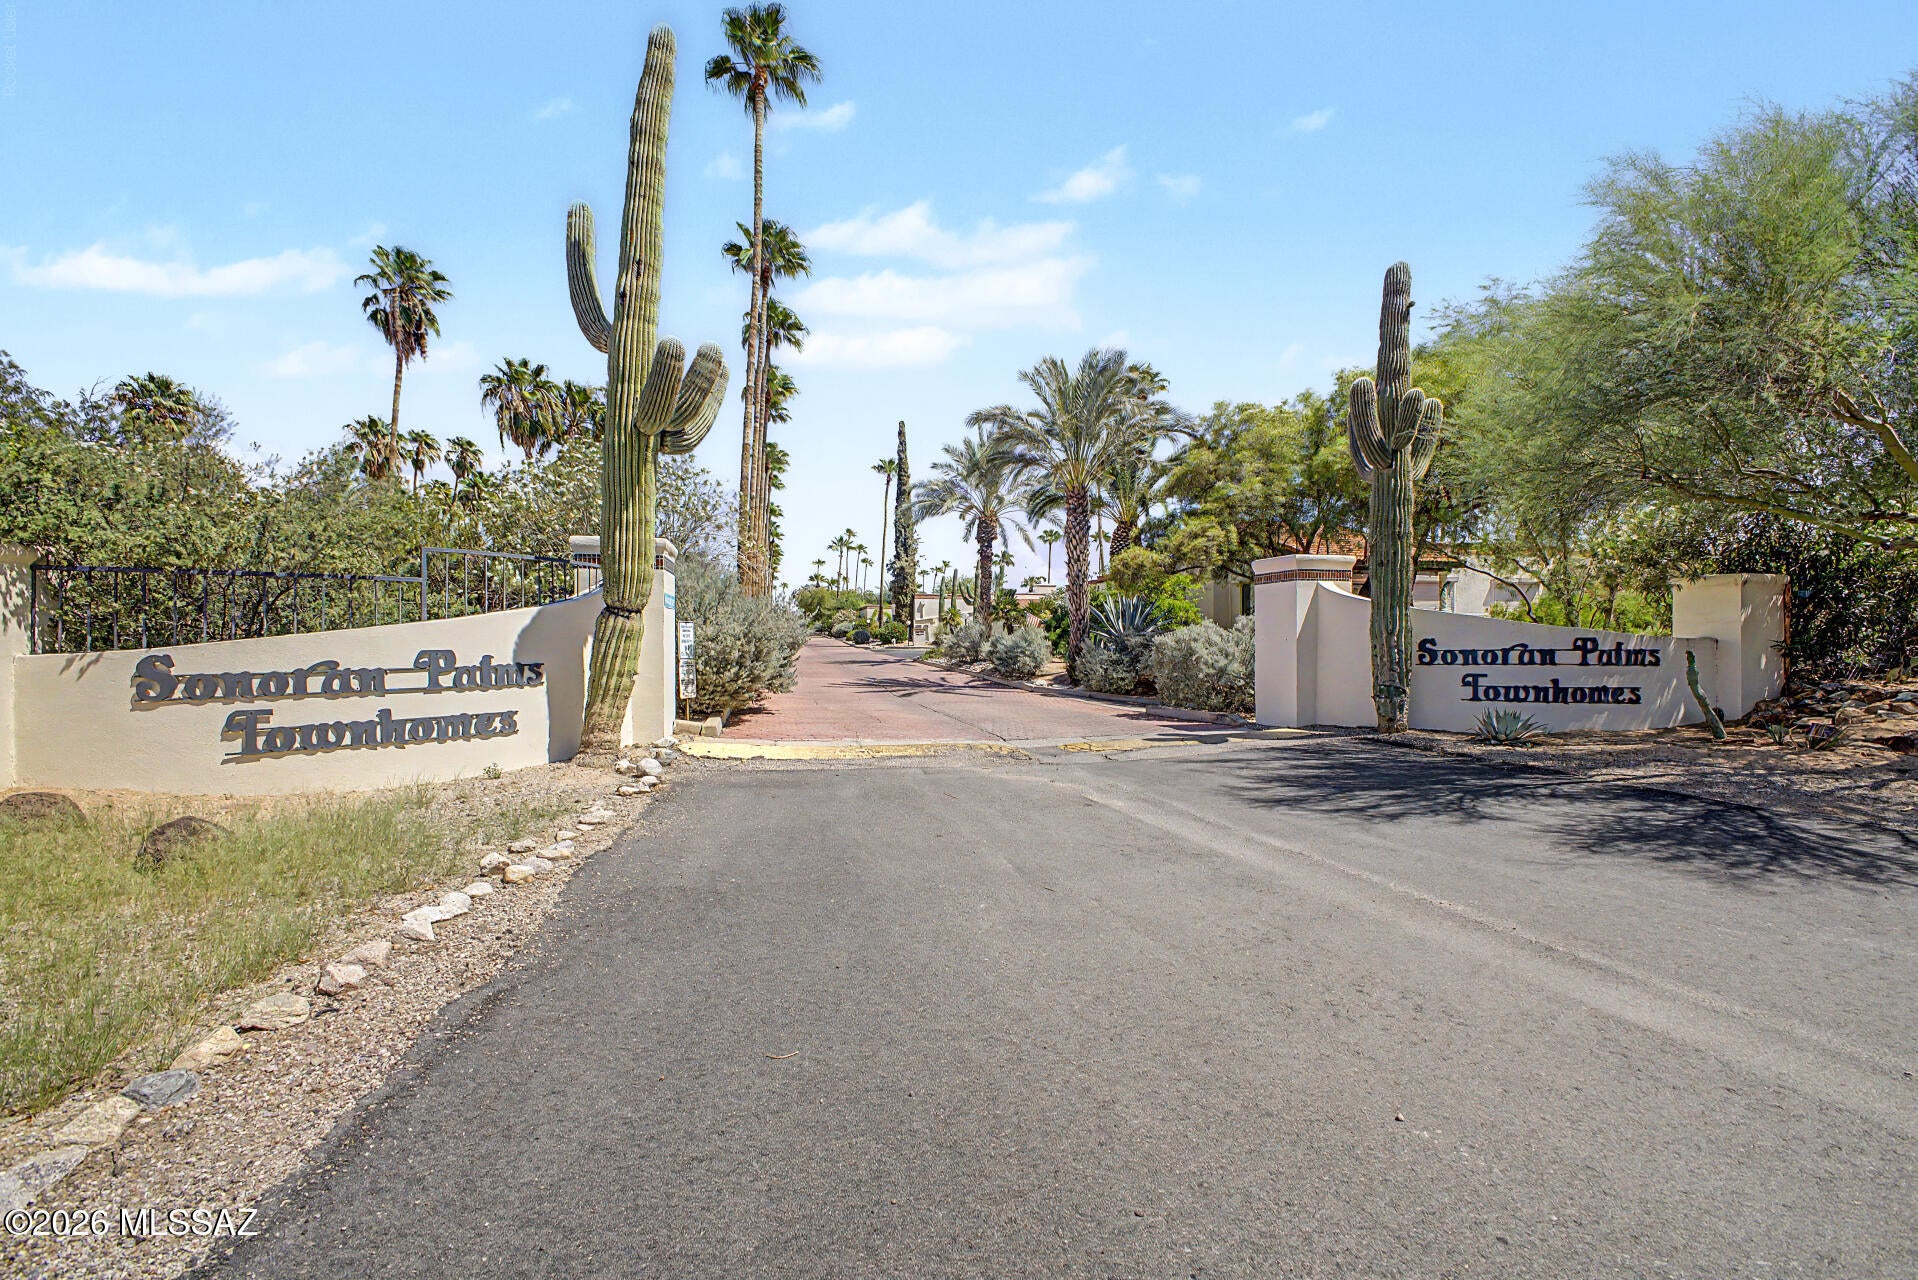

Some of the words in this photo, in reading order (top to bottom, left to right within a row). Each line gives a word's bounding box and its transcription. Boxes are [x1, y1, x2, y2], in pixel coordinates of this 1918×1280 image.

[1416, 638, 1557, 666] Sonoran
[1572, 636, 1661, 667] Palms
[132, 653, 387, 702] Sonoran
[413, 649, 545, 691] Palms
[1461, 672, 1642, 704] Townhomes
[222, 707, 519, 757] Townhomes
